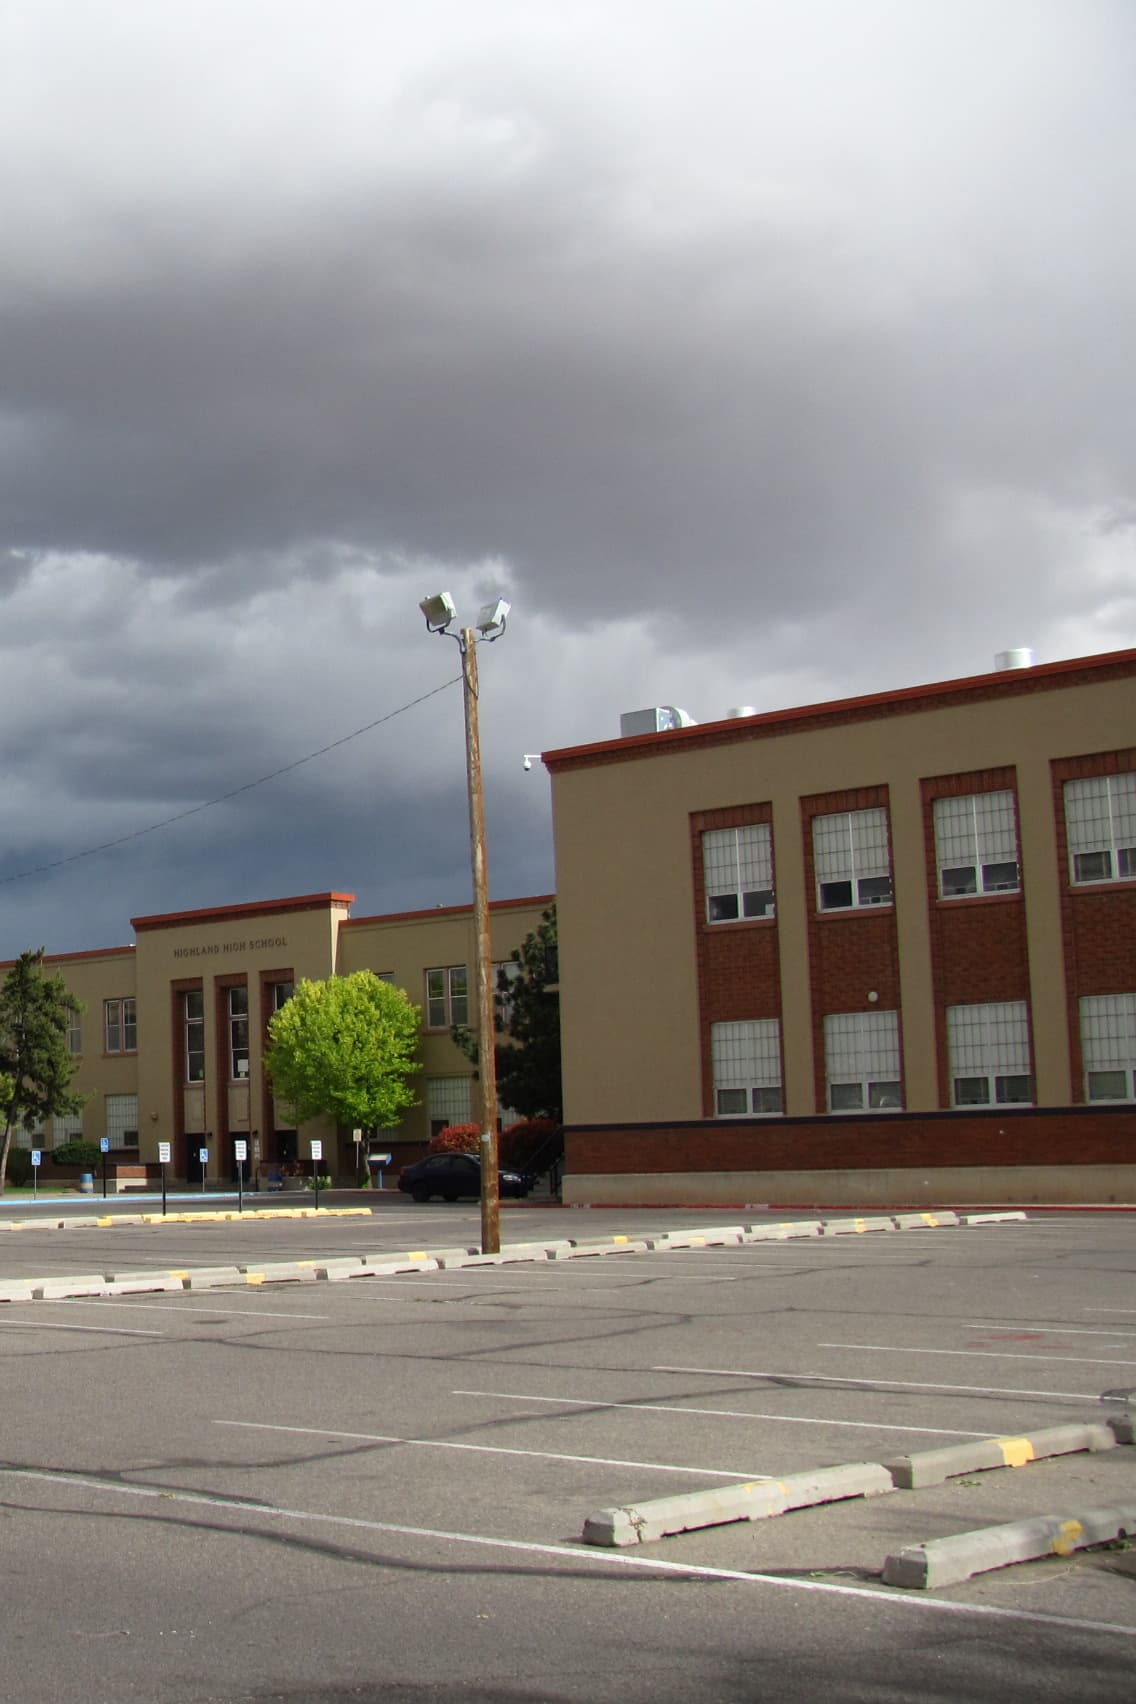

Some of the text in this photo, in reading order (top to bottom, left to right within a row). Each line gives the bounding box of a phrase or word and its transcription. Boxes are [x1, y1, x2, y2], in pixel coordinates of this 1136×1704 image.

[173, 937, 288, 959] HIGHLAND HIGH SCHOOL
